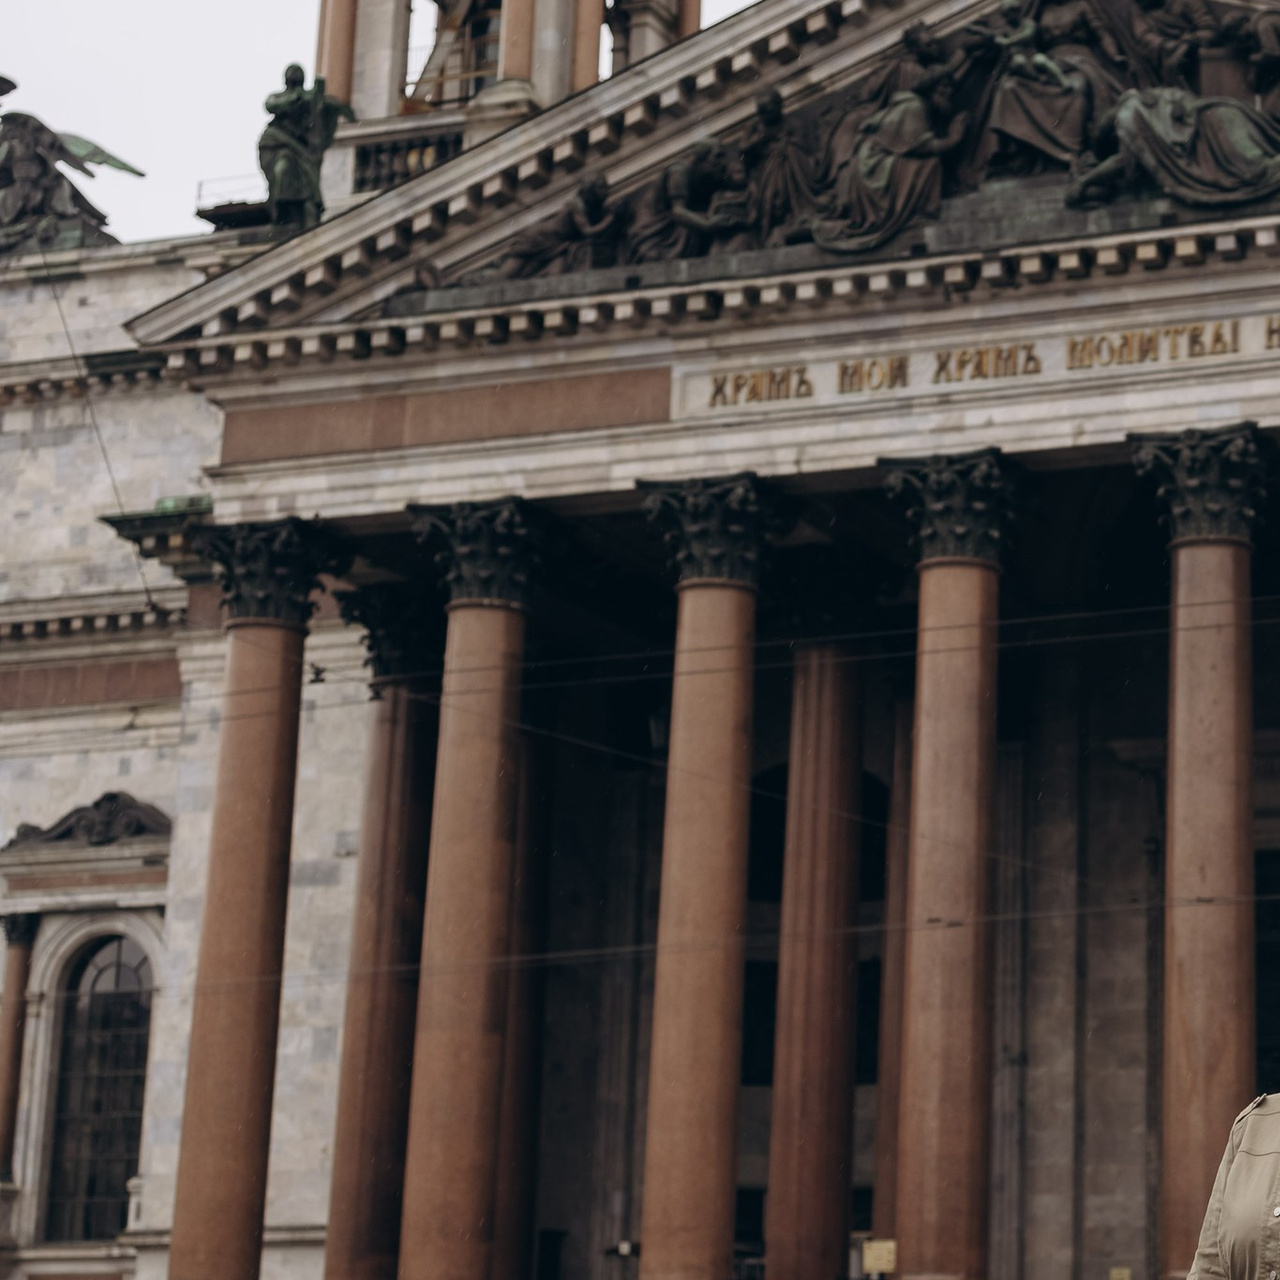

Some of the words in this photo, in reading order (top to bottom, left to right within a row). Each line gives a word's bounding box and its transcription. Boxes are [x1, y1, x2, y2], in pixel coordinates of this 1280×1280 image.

[709, 365, 814, 407] ХРАМЪ
[932, 342, 1042, 384] ХРАМЪ
[1066, 320, 1240, 369] МОЛИТВЫ
